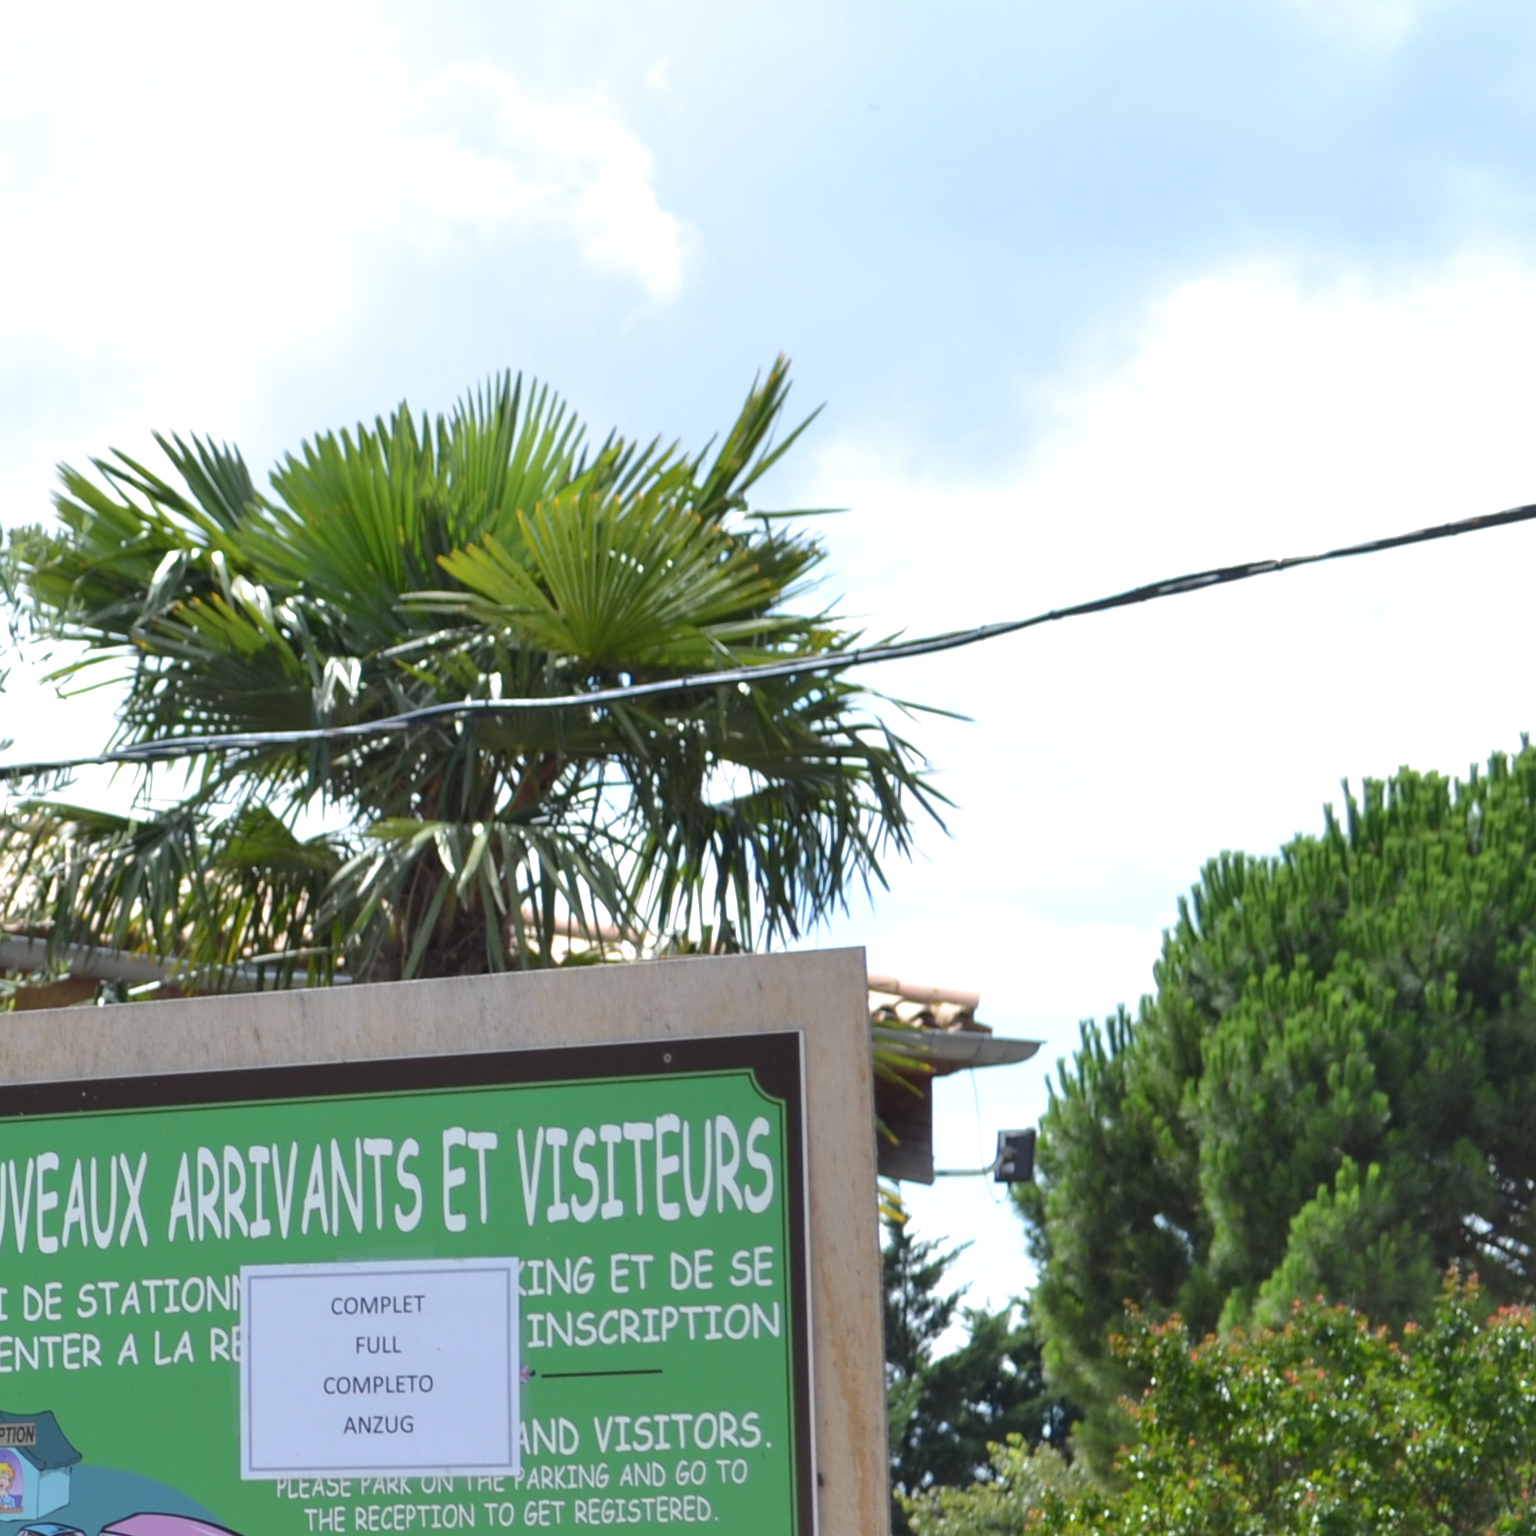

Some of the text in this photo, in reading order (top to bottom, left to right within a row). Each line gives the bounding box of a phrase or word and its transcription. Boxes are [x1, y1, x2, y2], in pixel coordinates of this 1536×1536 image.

[168, 1136, 423, 1243] ARRIVANTS
[442, 1126, 498, 1233] ET
[516, 1113, 775, 1228] VISITEURS
[23, 1282, 63, 1321] DE
[610, 1252, 654, 1291] ET
[670, 1248, 714, 1291] DE
[729, 1245, 774, 1288] SE
[331, 1295, 425, 1315] COMPLET
[117, 1333, 139, 1366] A
[154, 1330, 195, 1366] LA
[526, 1302, 780, 1349] INSCRIPTION
[355, 1335, 402, 1355] FULL
[323, 1374, 434, 1395] COMPLETO
[343, 1415, 414, 1434] ANZUG
[593, 1411, 772, 1454] VISITORS.
[277, 1477, 352, 1499] PLEASE
[361, 1476, 412, 1496] PARK
[421, 1475, 454, 1494] ON
[515, 1461, 610, 1491] PARKING
[619, 1461, 667, 1488] AND
[675, 1460, 706, 1486] GO
[716, 1458, 748, 1484] TO
[304, 1494, 720, 1532] THE RECEPTION TO GET REGISTERED.
